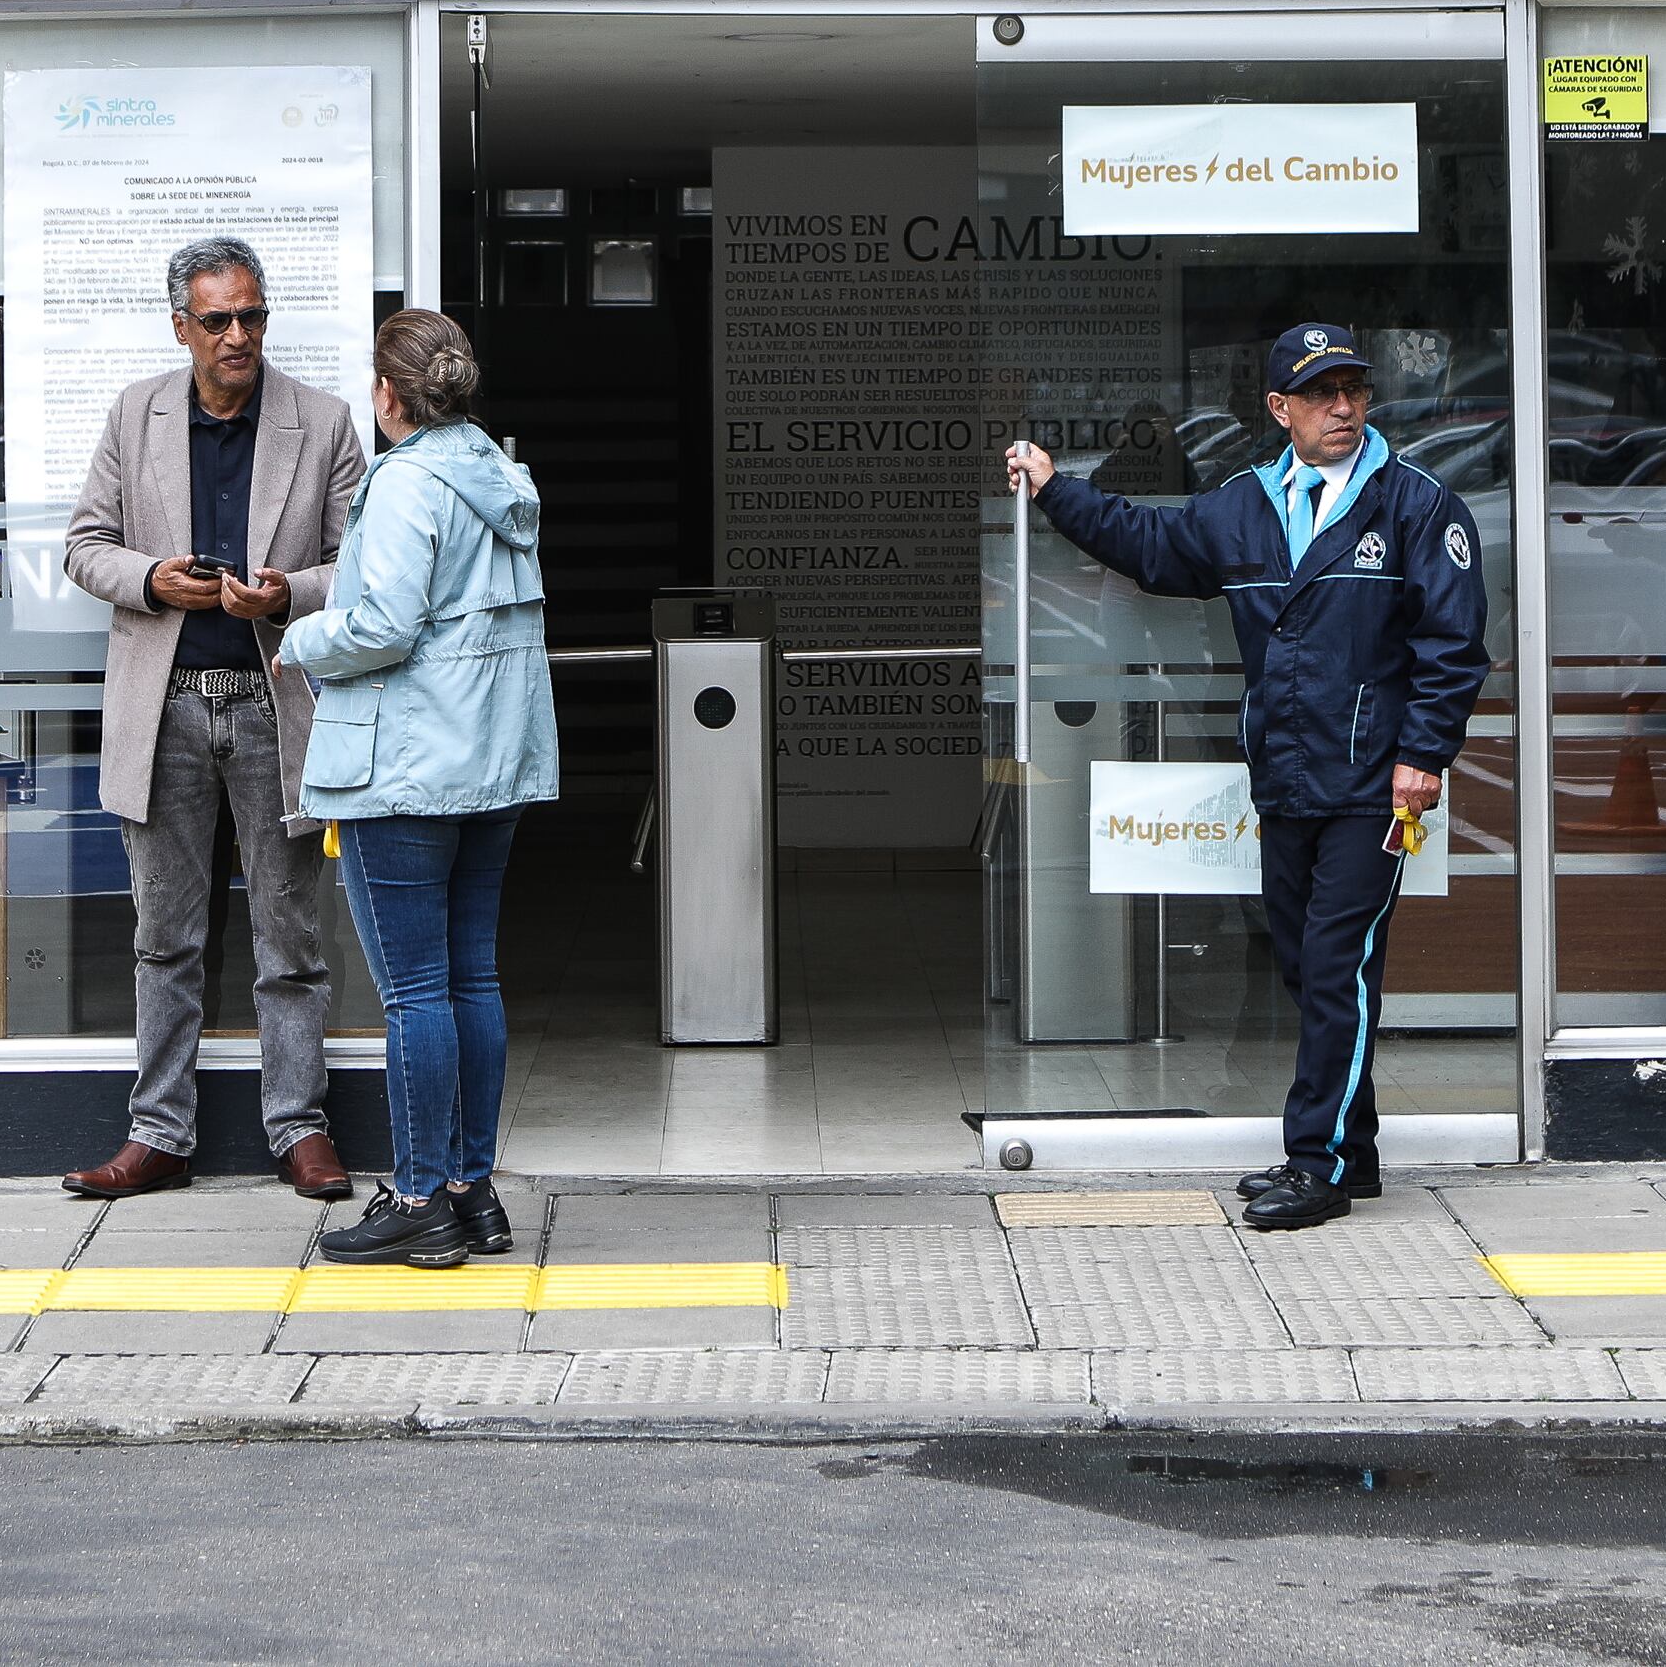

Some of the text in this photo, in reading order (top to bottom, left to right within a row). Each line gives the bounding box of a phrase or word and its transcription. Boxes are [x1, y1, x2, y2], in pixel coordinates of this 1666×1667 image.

[1548, 57, 1643, 76] ¡ATENCIÓN!
[106, 98, 156, 112] sintra
[96, 113, 176, 126] minerales
[124, 177, 174, 185] COMUNICADO
[194, 175, 223, 184] OPINIÓN
[225, 174, 257, 184] PÚBLICA
[1080, 155, 1399, 190] Mujeres del Cambio
[130, 192, 155, 200] SOBRE
[43, 208, 110, 216] SINTRAMINERALES
[309, 215, 338, 223] principal
[725, 215, 887, 236] VIVIMOS EN
[903, 215, 1163, 262] CAMBIO.
[725, 243, 890, 264] TIEMPOS DE
[725, 269, 1163, 283] DONDE LA GENTE, LAS IDEAS, LAS CRISIS Y LAS SOLUCIONES
[725, 288, 794, 300] CRUZAN
[801, 288, 832, 300] LAS
[839, 288, 939, 300] FRONTERAS
[946, 286, 981, 299] MÁS
[1057, 287, 1092, 299] QUE
[1099, 287, 1157, 299] NUNCA
[725, 306, 778, 317] CUANDO
[781, 306, 867, 317] ESCUCHAMOS
[871, 306, 921, 317] NUEVAS
[924, 306, 967, 317] VOCES,
[970, 305, 1020, 315] NUEVAS
[1023, 305, 1097, 315] FRONTERAS
[726, 321, 1162, 337] ESTAMOS EN UN TIEMPO DE OPORTUNIDADES
[726, 366, 1162, 385] TAMBIÉN ES UN TIEMPO DE GRANDES RETOS
[726, 390, 756, 404] QUE
[760, 390, 796, 402] SOLO
[800, 387, 859, 402] PODRÁN
[864, 390, 890, 401] SER
[895, 390, 976, 401] RESUELTOS
[980, 389, 1008, 401] POR
[1013, 389, 1056, 401] MEDIO
[726, 416, 1162, 455] EL SERVICIO PÚBLICO,
[725, 491, 980, 509] TENDIENDO PUENTES
[726, 546, 908, 570] CONFIANZA.
[785, 575, 841, 586] NUEVAS
[780, 606, 918, 619] SUFICIENTEMENTE
[786, 662, 951, 687] SERVIMOS
[803, 691, 924, 716] TAMBIÉN
[798, 737, 887, 758] QUE LA
[1108, 815, 1227, 848] Mujeres
